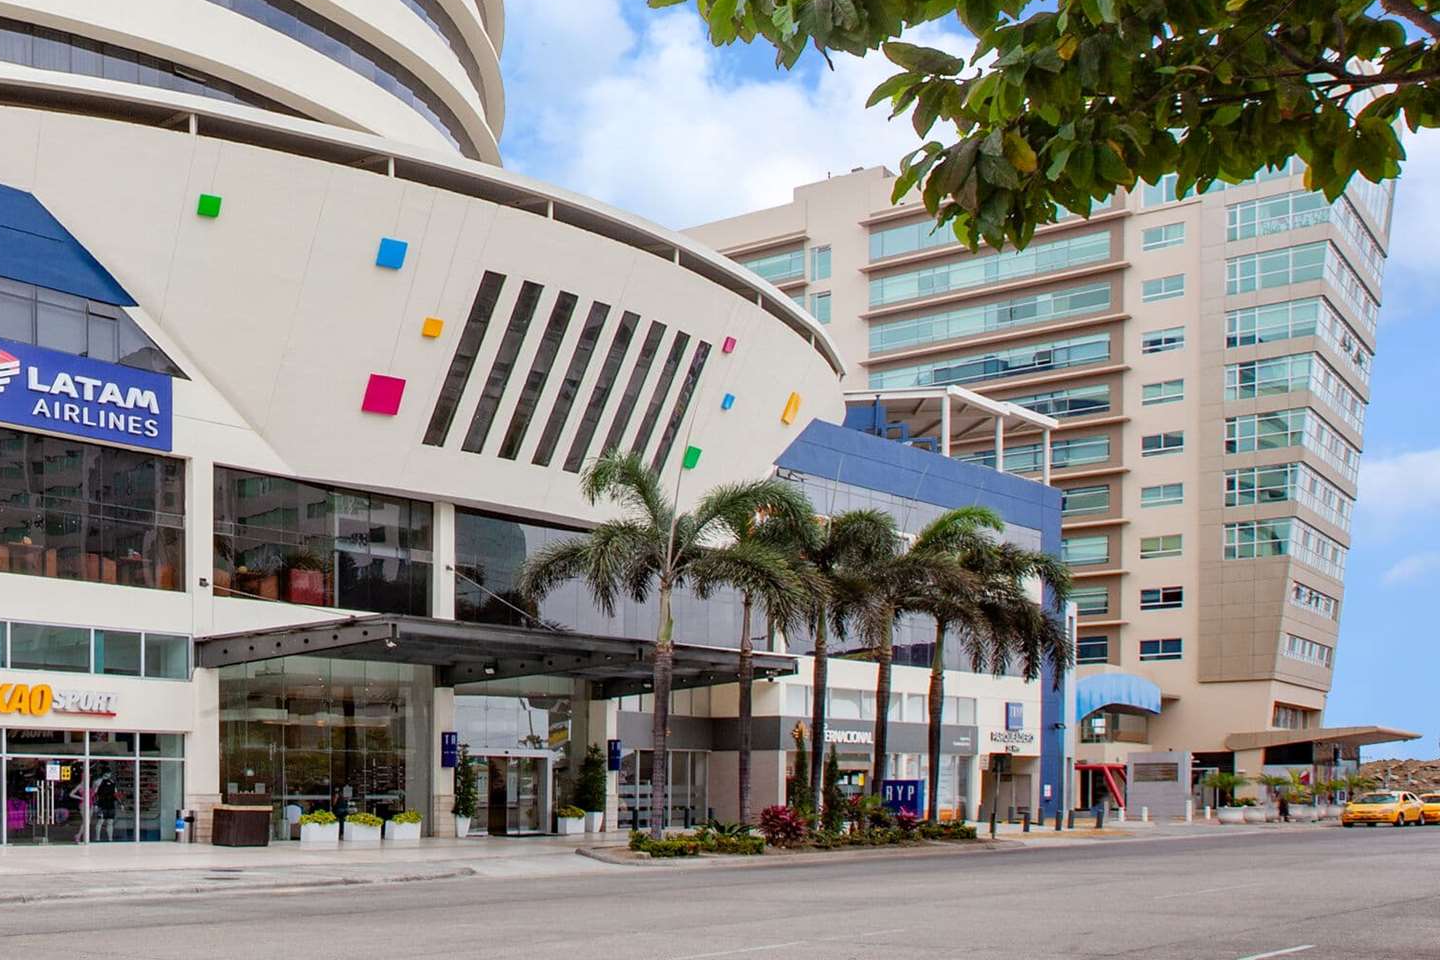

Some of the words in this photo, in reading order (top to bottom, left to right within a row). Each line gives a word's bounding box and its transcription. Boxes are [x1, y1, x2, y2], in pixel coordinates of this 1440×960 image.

[26, 366, 160, 415] LATAM
[31, 398, 160, 438] AIRLINES
[52, 691, 118, 712] SPORT
